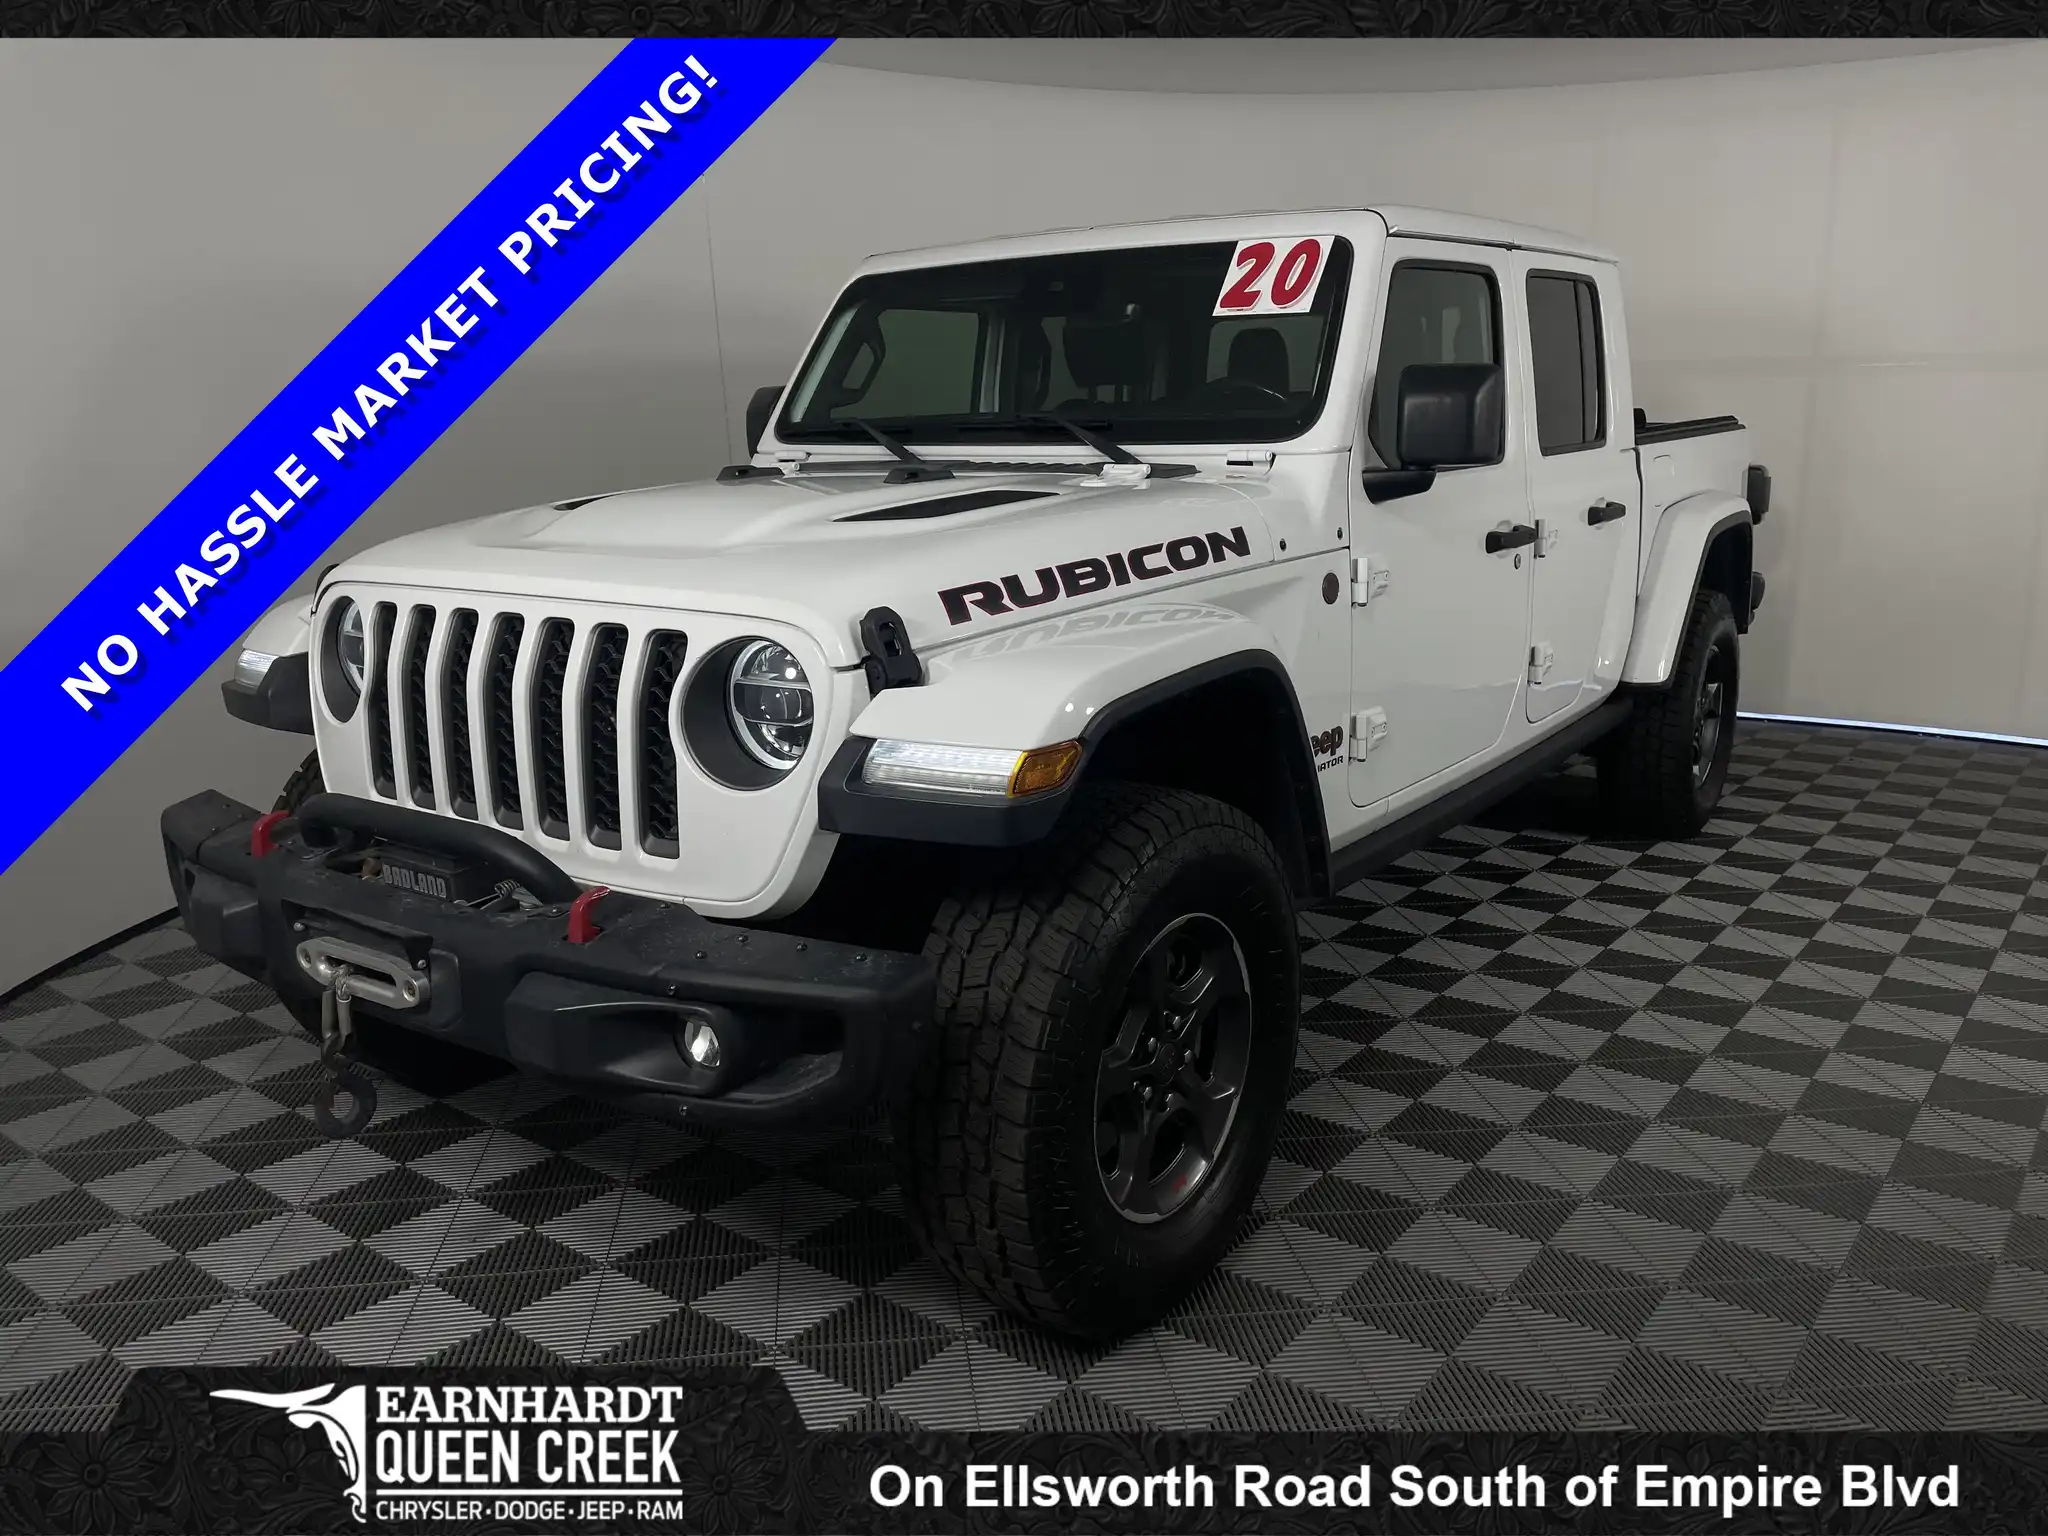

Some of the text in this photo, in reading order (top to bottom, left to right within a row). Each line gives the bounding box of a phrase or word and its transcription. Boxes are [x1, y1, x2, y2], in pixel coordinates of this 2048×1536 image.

[1219, 238, 1323, 309] 20
[938, 526, 1251, 626] RUBICON
[1310, 726, 1343, 757] eep
[1318, 755, 1343, 773] IATOR
[382, 864, 447, 898] BADLAND
